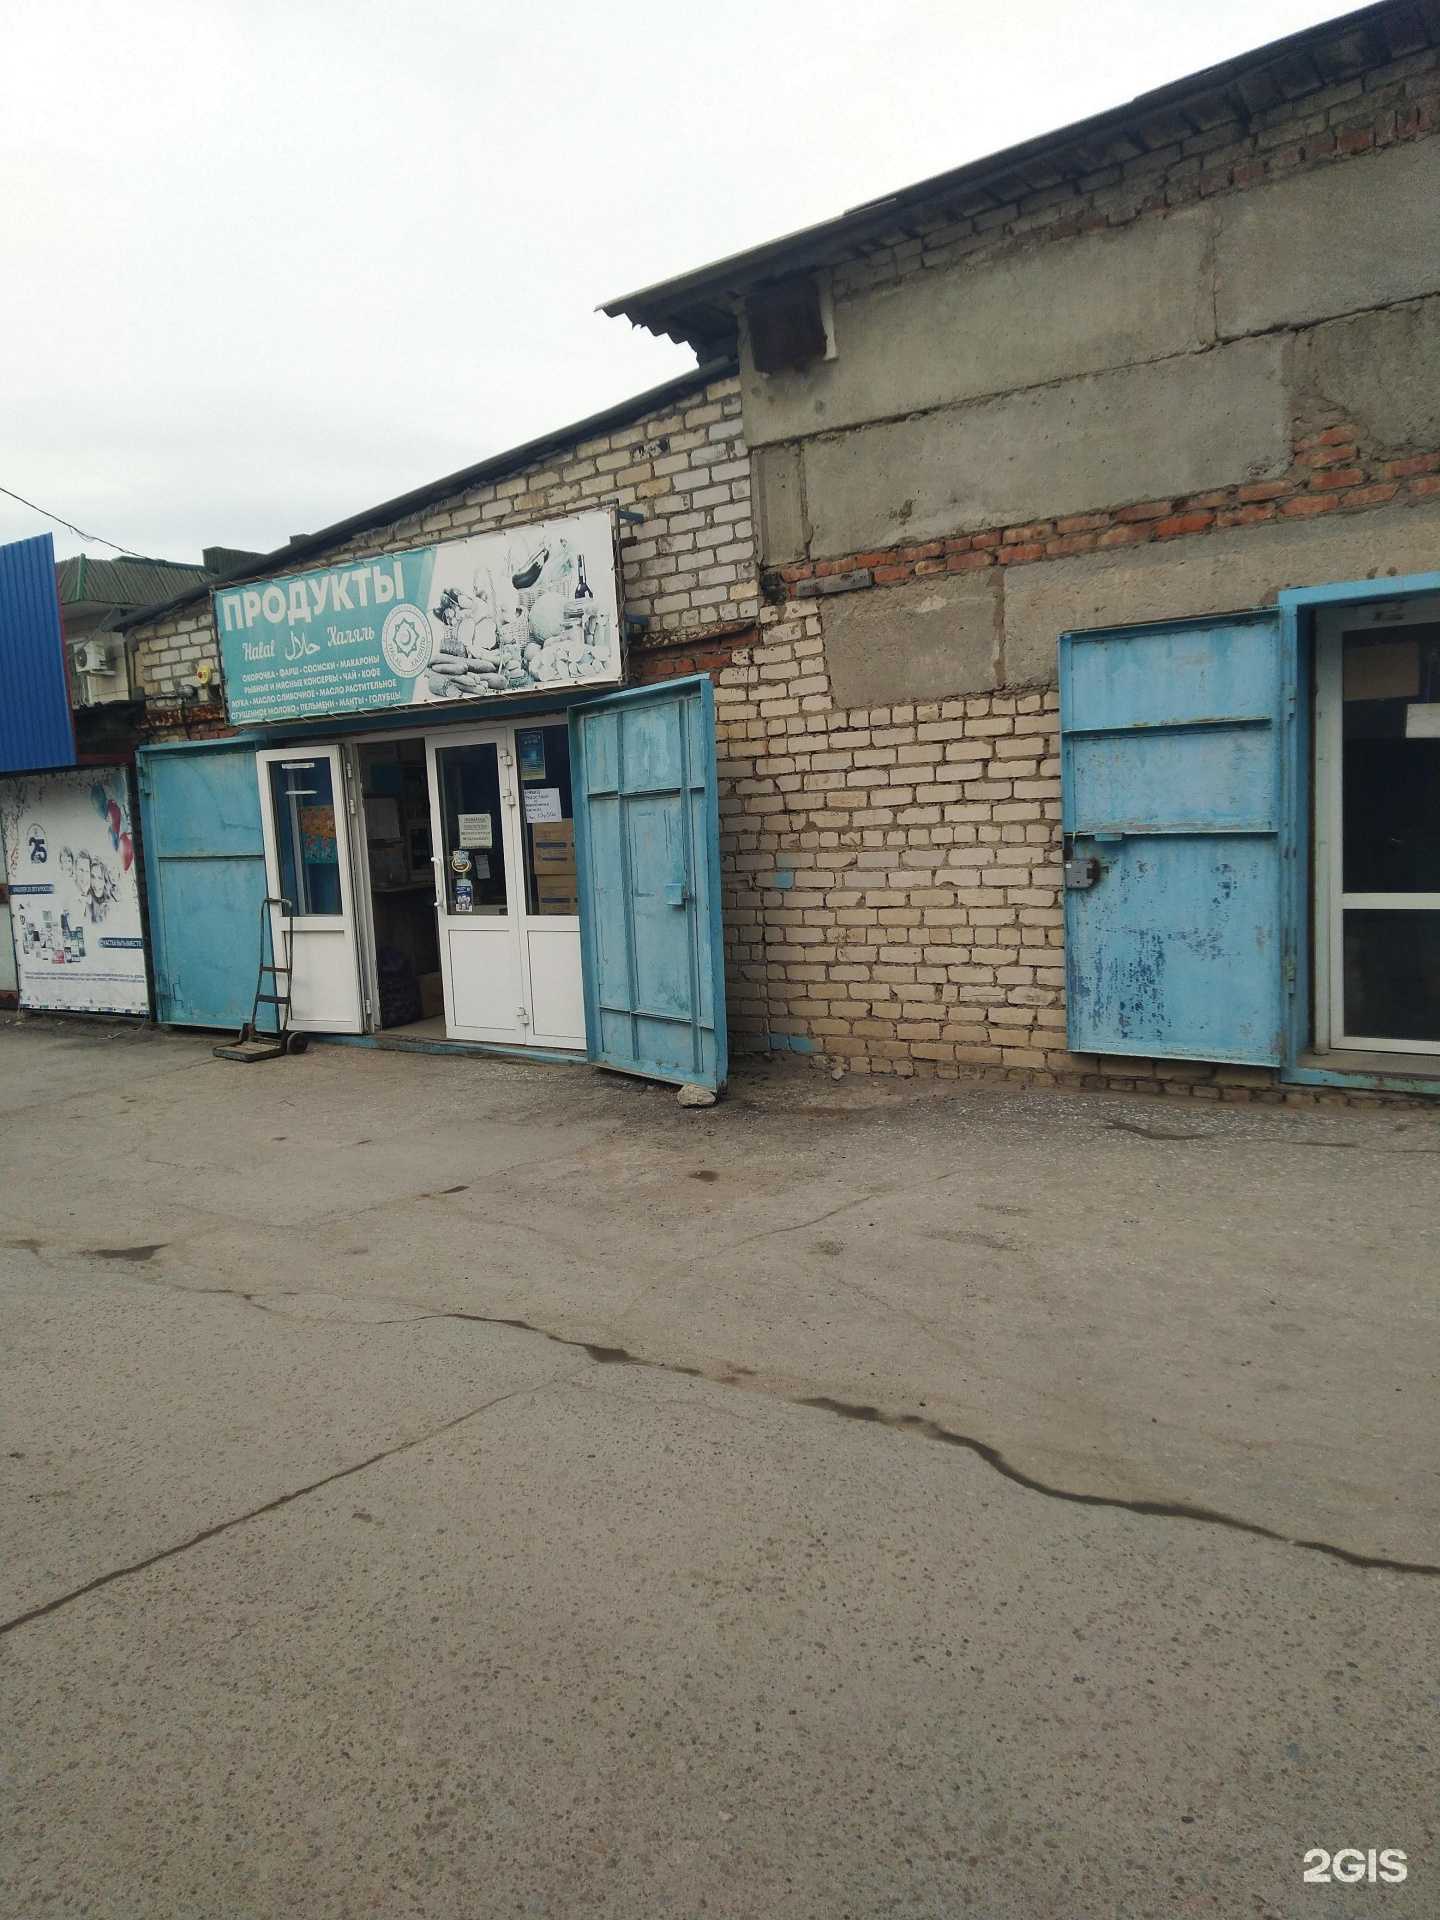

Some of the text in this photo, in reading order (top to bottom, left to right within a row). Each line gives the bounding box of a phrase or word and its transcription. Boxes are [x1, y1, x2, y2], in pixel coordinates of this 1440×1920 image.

[222, 561, 404, 631] ПРОДУКТЫ
[285, 631, 321, 660] حلال
[327, 624, 375, 647] Халяль
[242, 640, 276, 661] Halal
[303, 661, 336, 673] СОСИСКИ
[340, 655, 380, 669] МАКАРОНЫ
[343, 670, 357, 680] ЧАЙ
[362, 667, 381, 678] КОФЕ
[252, 694, 276, 705] МАСЛО
[320, 686, 345, 697] МАСЛО
[345, 679, 397, 693] РАСТИТЕЛЬНОЕ
[339, 695, 364, 706] МАНТЫ
[29, 837, 47, 863] 25
